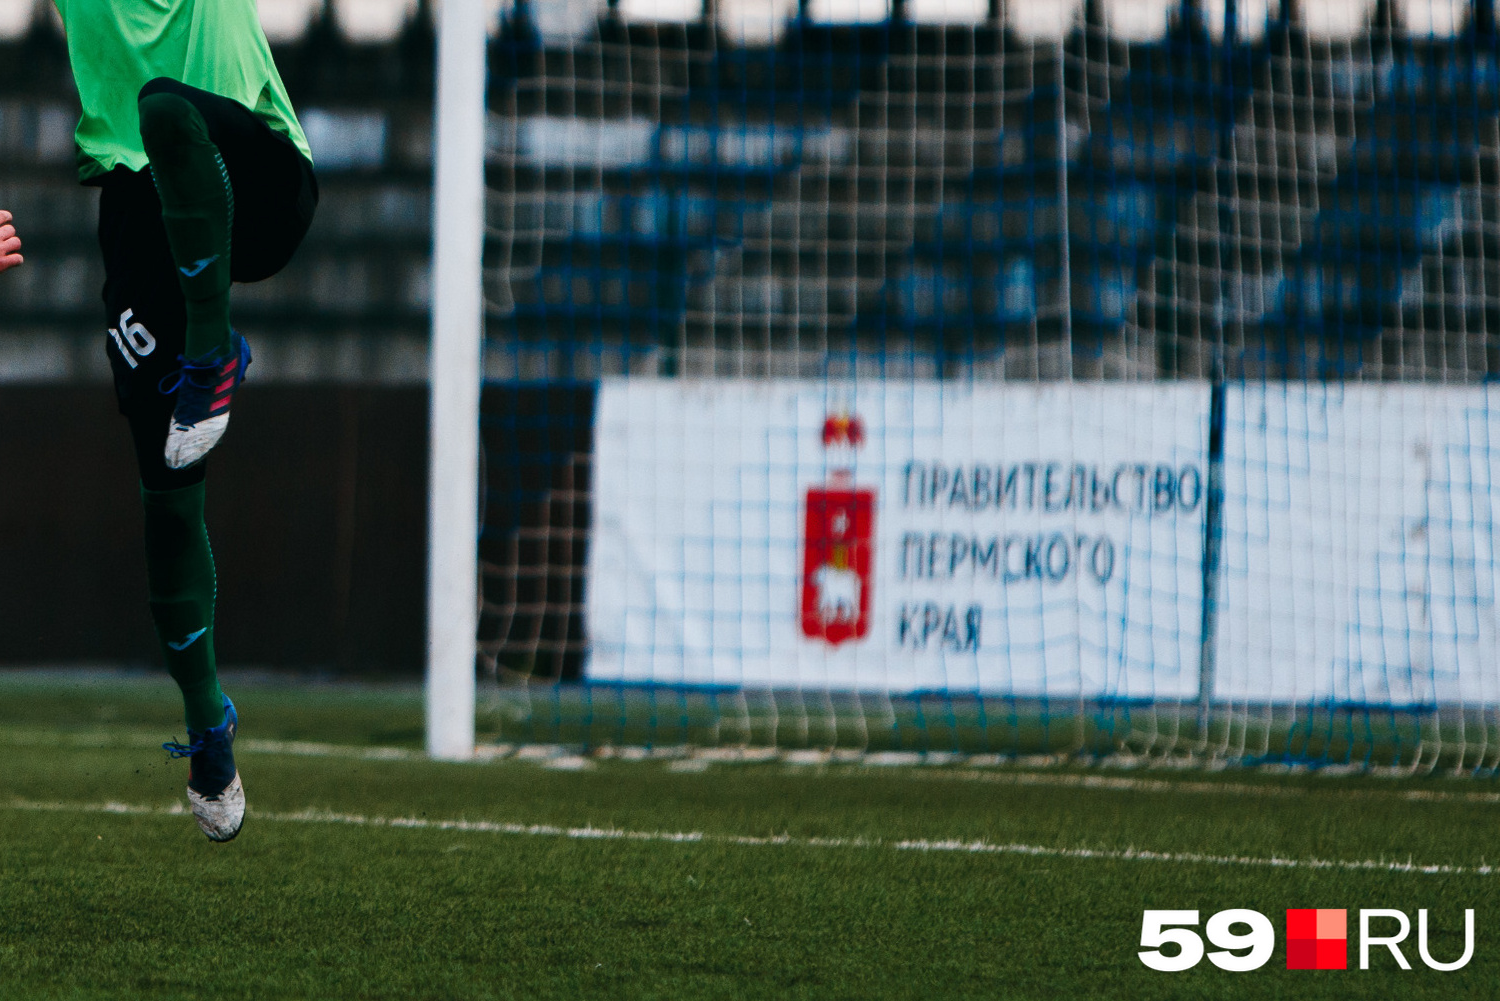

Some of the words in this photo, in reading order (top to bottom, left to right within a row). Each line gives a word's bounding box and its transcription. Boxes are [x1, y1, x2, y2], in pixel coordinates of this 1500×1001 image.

[108, 308, 156, 369] 16
[902, 459, 1202, 514] ПРАВИТЕЛЬСТВО
[901, 531, 1116, 583] ПЕРМСКОГО
[898, 601, 982, 651] КРАЯ
